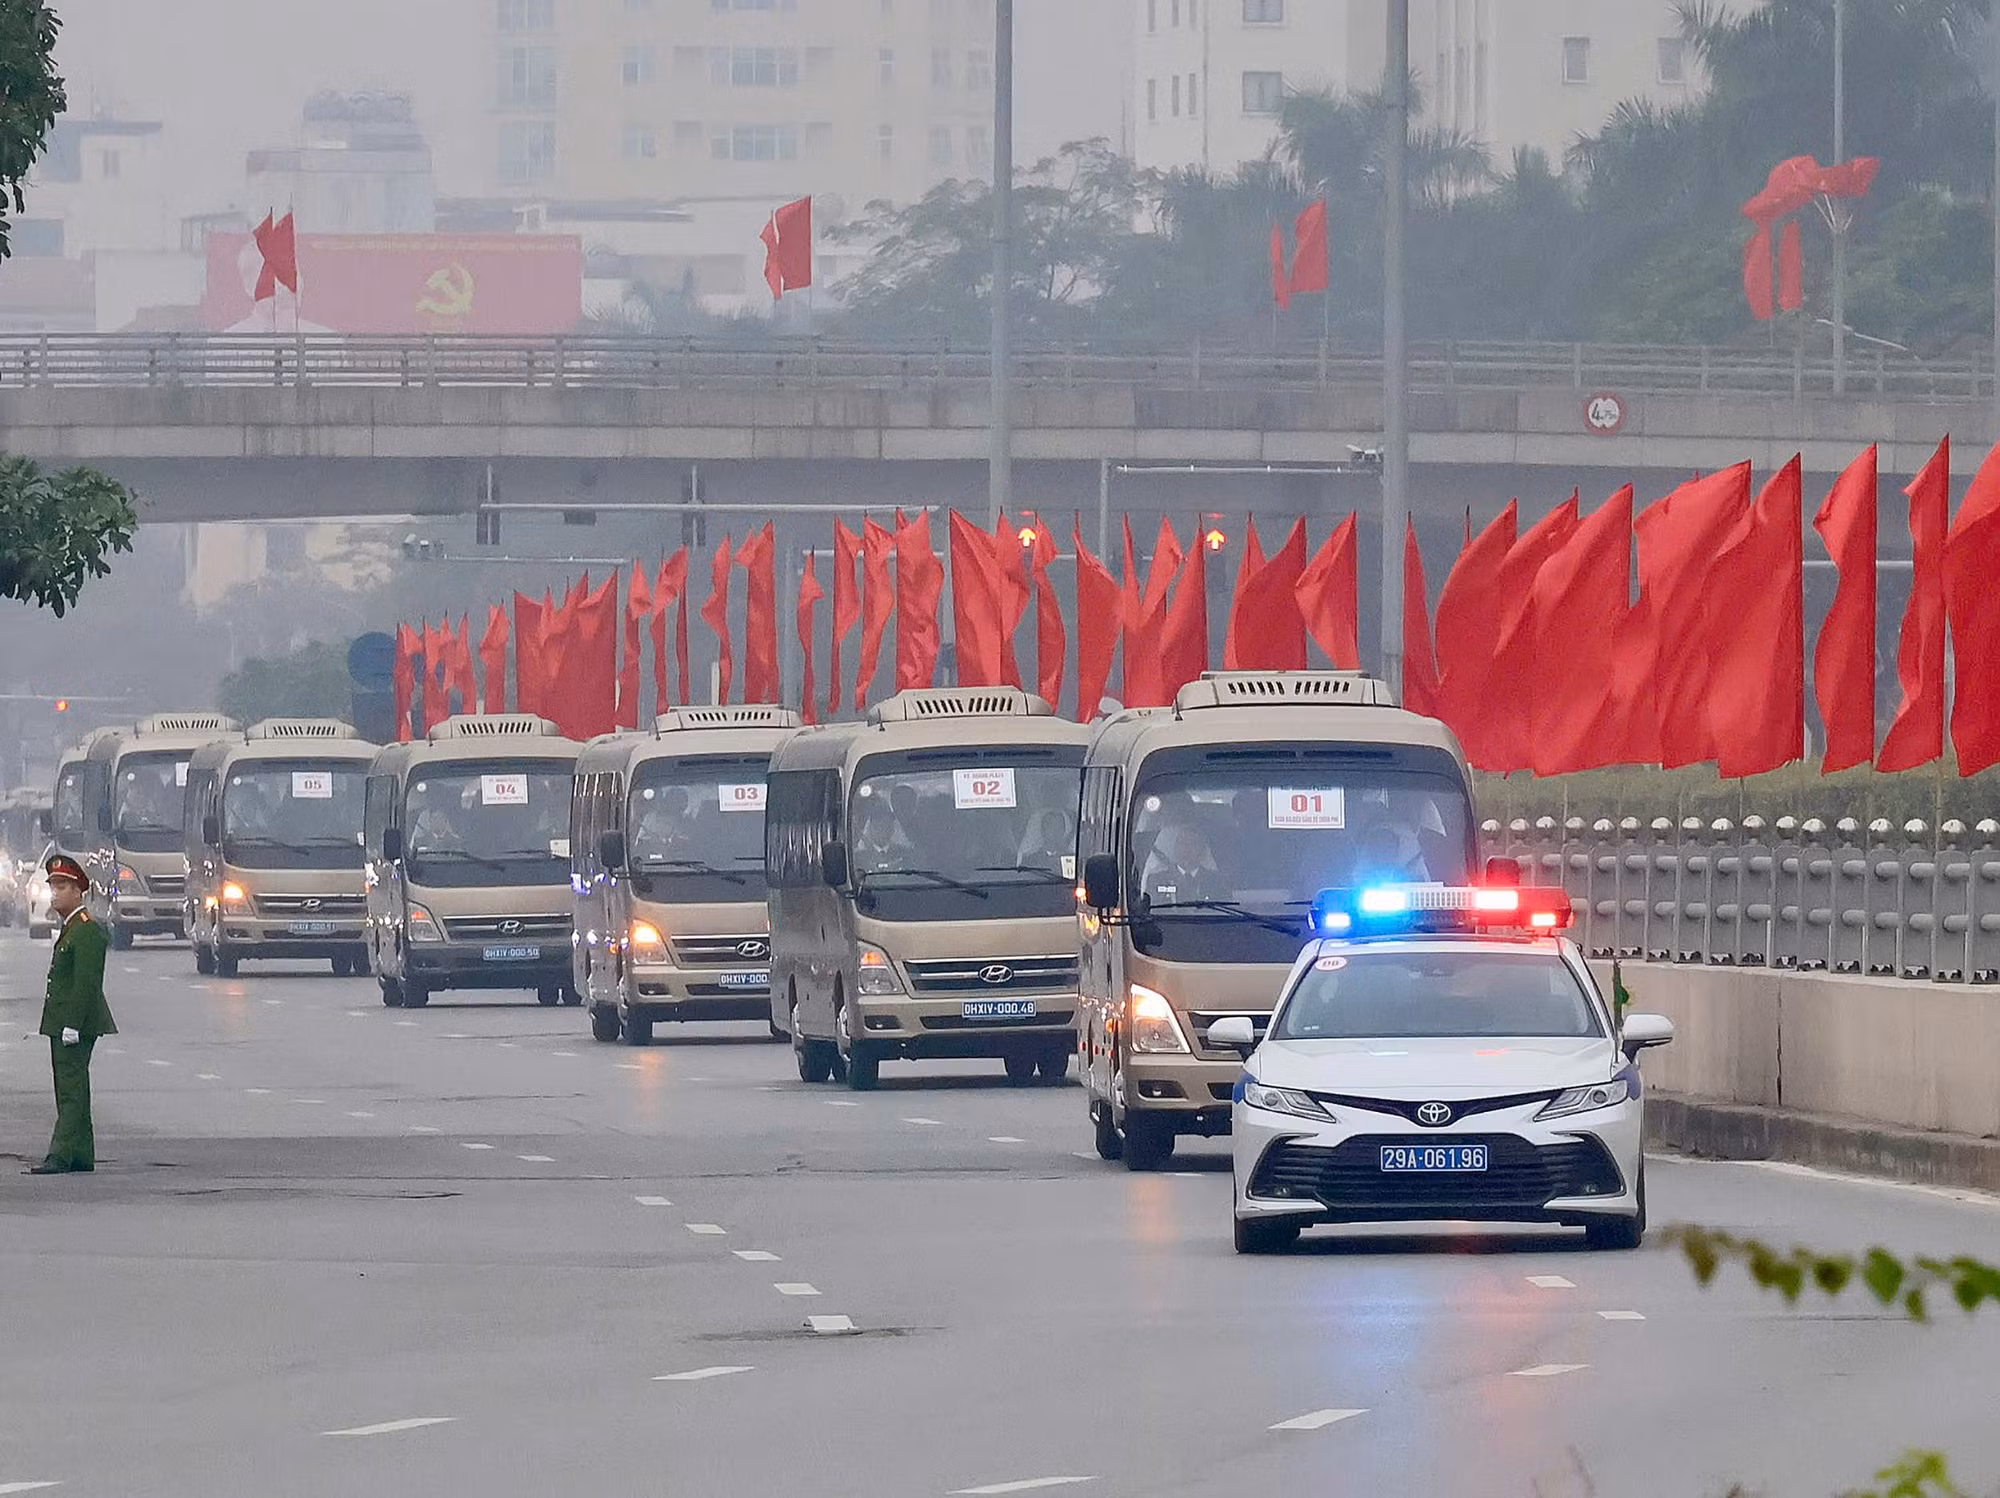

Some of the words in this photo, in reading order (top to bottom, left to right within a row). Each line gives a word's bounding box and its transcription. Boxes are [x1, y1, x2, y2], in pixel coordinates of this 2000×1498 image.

[496, 783, 516, 795] 04
[735, 787, 758, 800] 03
[973, 780, 1001, 796] 02
[1291, 795, 1322, 813] 01
[1384, 1148, 1484, 1169] 29A-061.96
